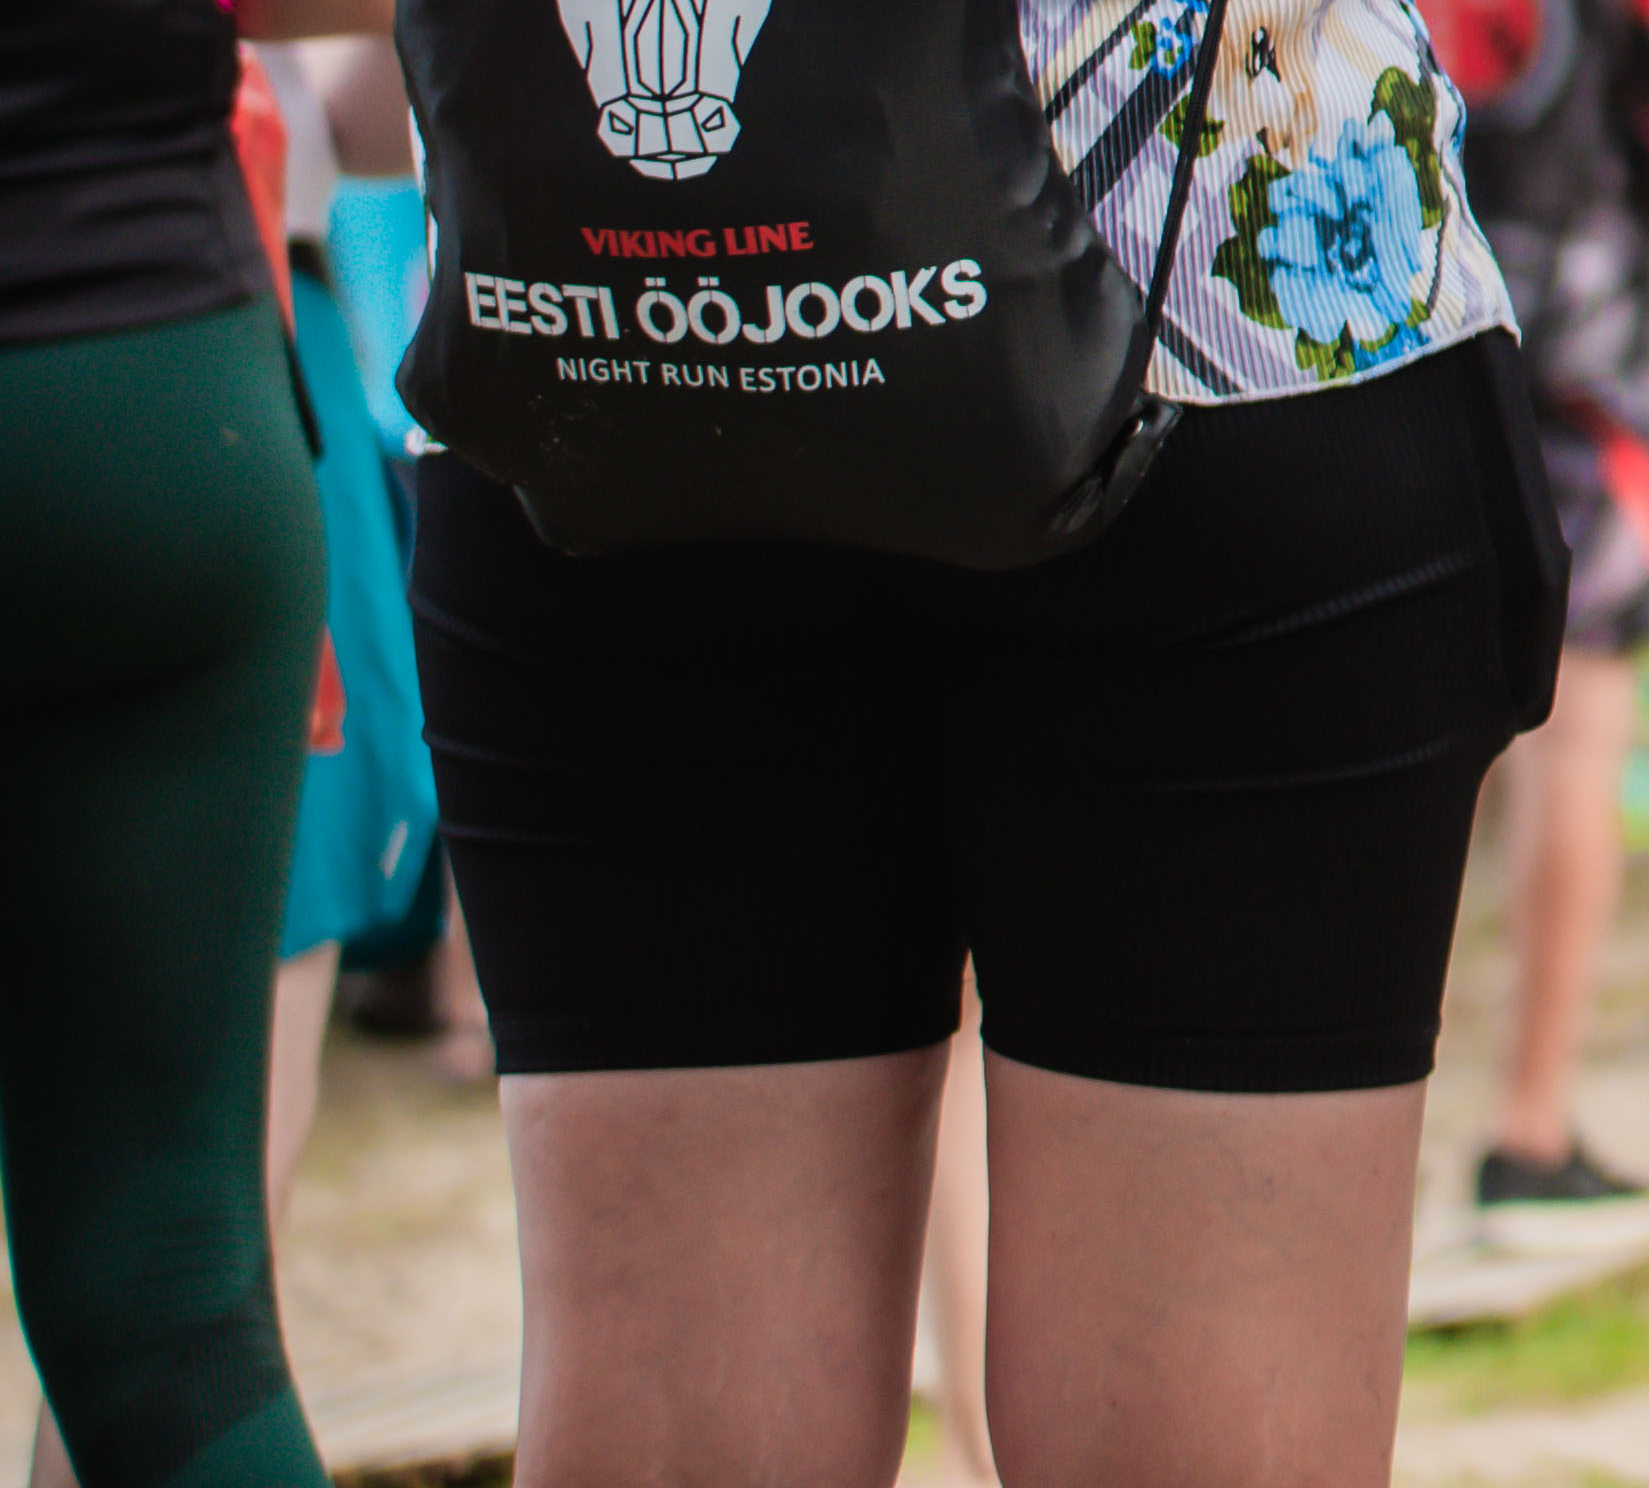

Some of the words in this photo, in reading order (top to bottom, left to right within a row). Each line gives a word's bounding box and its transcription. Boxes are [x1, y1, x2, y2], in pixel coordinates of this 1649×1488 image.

[580, 225, 717, 259] VIKING
[724, 220, 815, 257] LINE
[463, 270, 621, 341] EESTI
[636, 257, 988, 347] ÖÖJOOKS
[556, 357, 651, 387] NIGHT
[661, 360, 731, 390] RUN
[740, 357, 887, 393] ESTONIA
